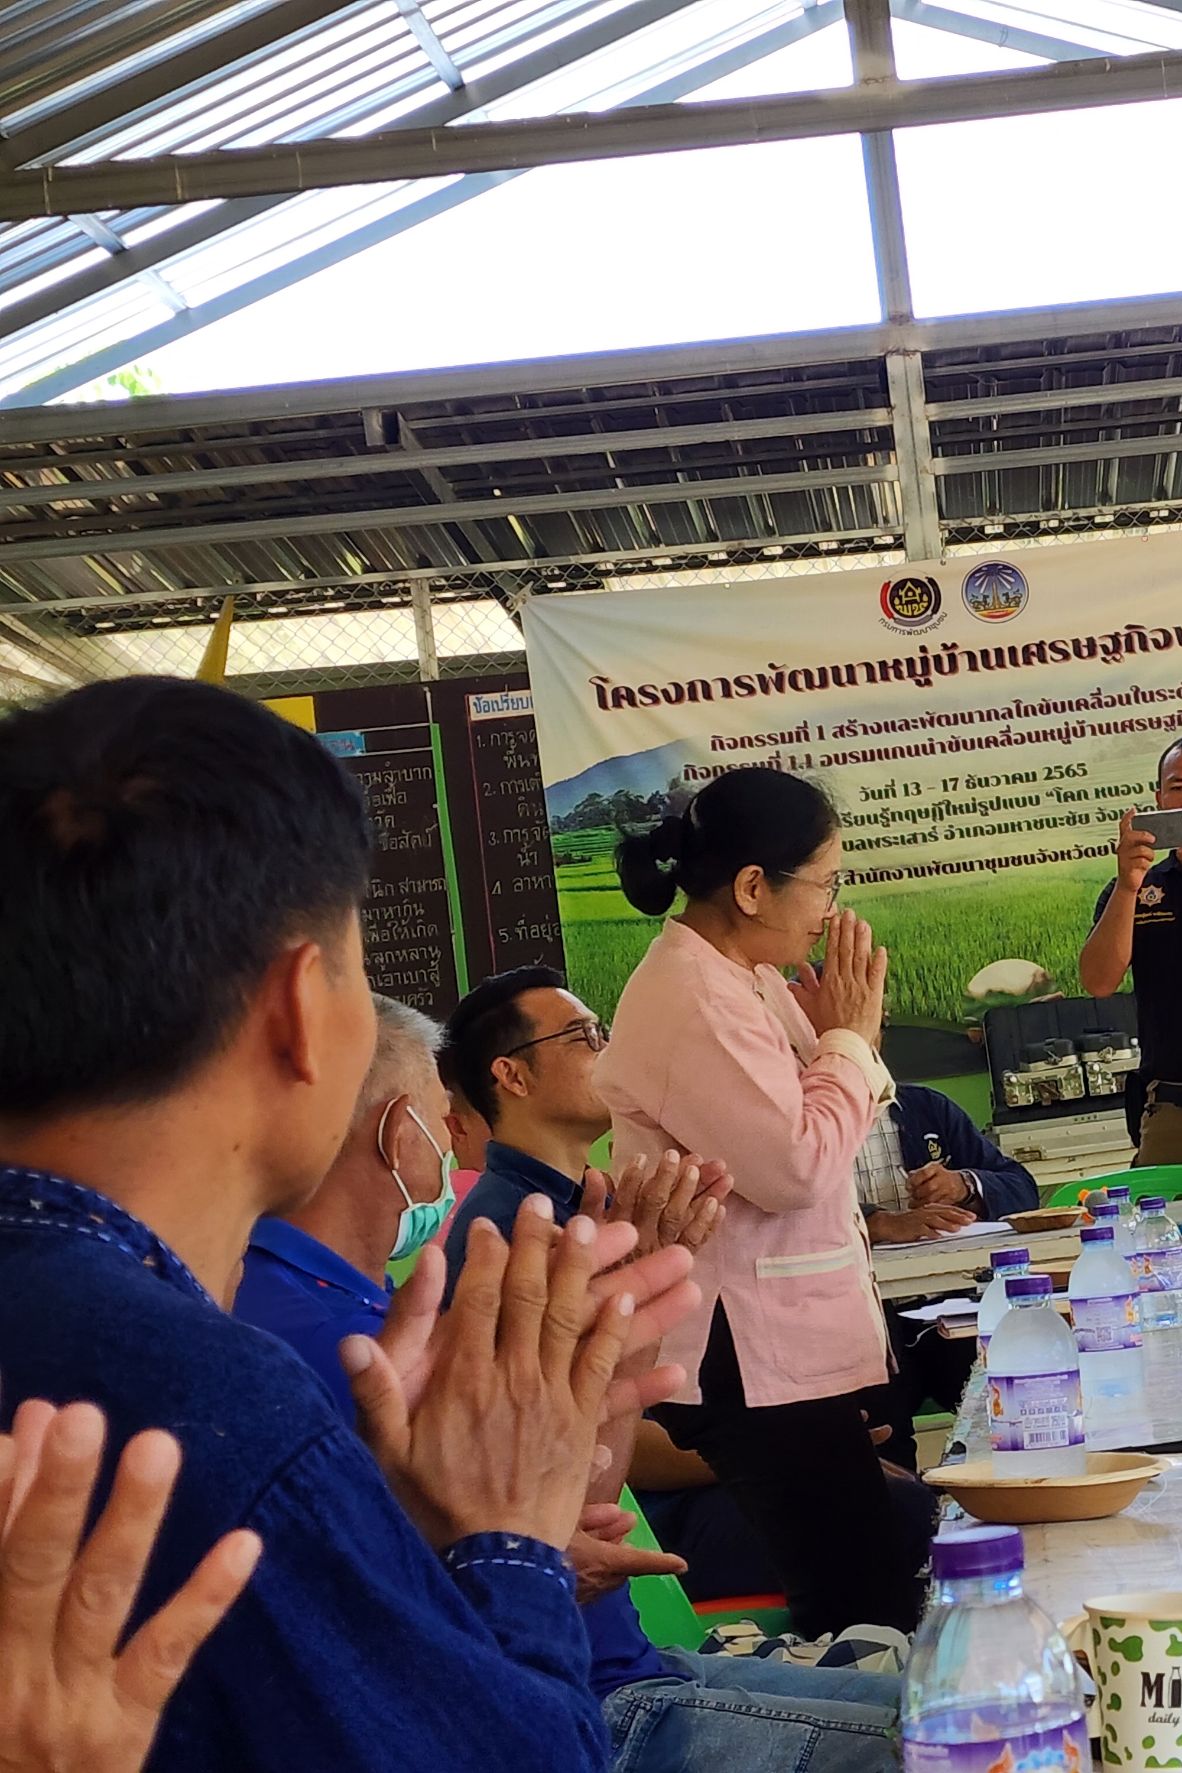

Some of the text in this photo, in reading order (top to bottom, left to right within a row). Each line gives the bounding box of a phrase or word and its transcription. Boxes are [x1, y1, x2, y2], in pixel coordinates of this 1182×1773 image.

[473, 692, 534, 714] ข้อเปรียบ
[710, 720, 811, 752] กิจกรรมที่
[817, 725, 826, 741] 1
[859, 779, 897, 802] วันที่
[902, 782, 923, 797] 13
[942, 777, 959, 792] 17
[965, 770, 1038, 790] ธันวาคม
[1043, 762, 1088, 781] 2565
[1095, 782, 1144, 799] หนอง
[841, 825, 939, 852] บลพระเสาร์
[944, 810, 1090, 841] อำเภอมหาชนะชัย
[843, 838, 1119, 887] สำนักงานพัฒนาชุมชนจังหวัดยโ
[512, 874, 552, 893] อาหา
[1148, 1711, 1181, 1728] daily
